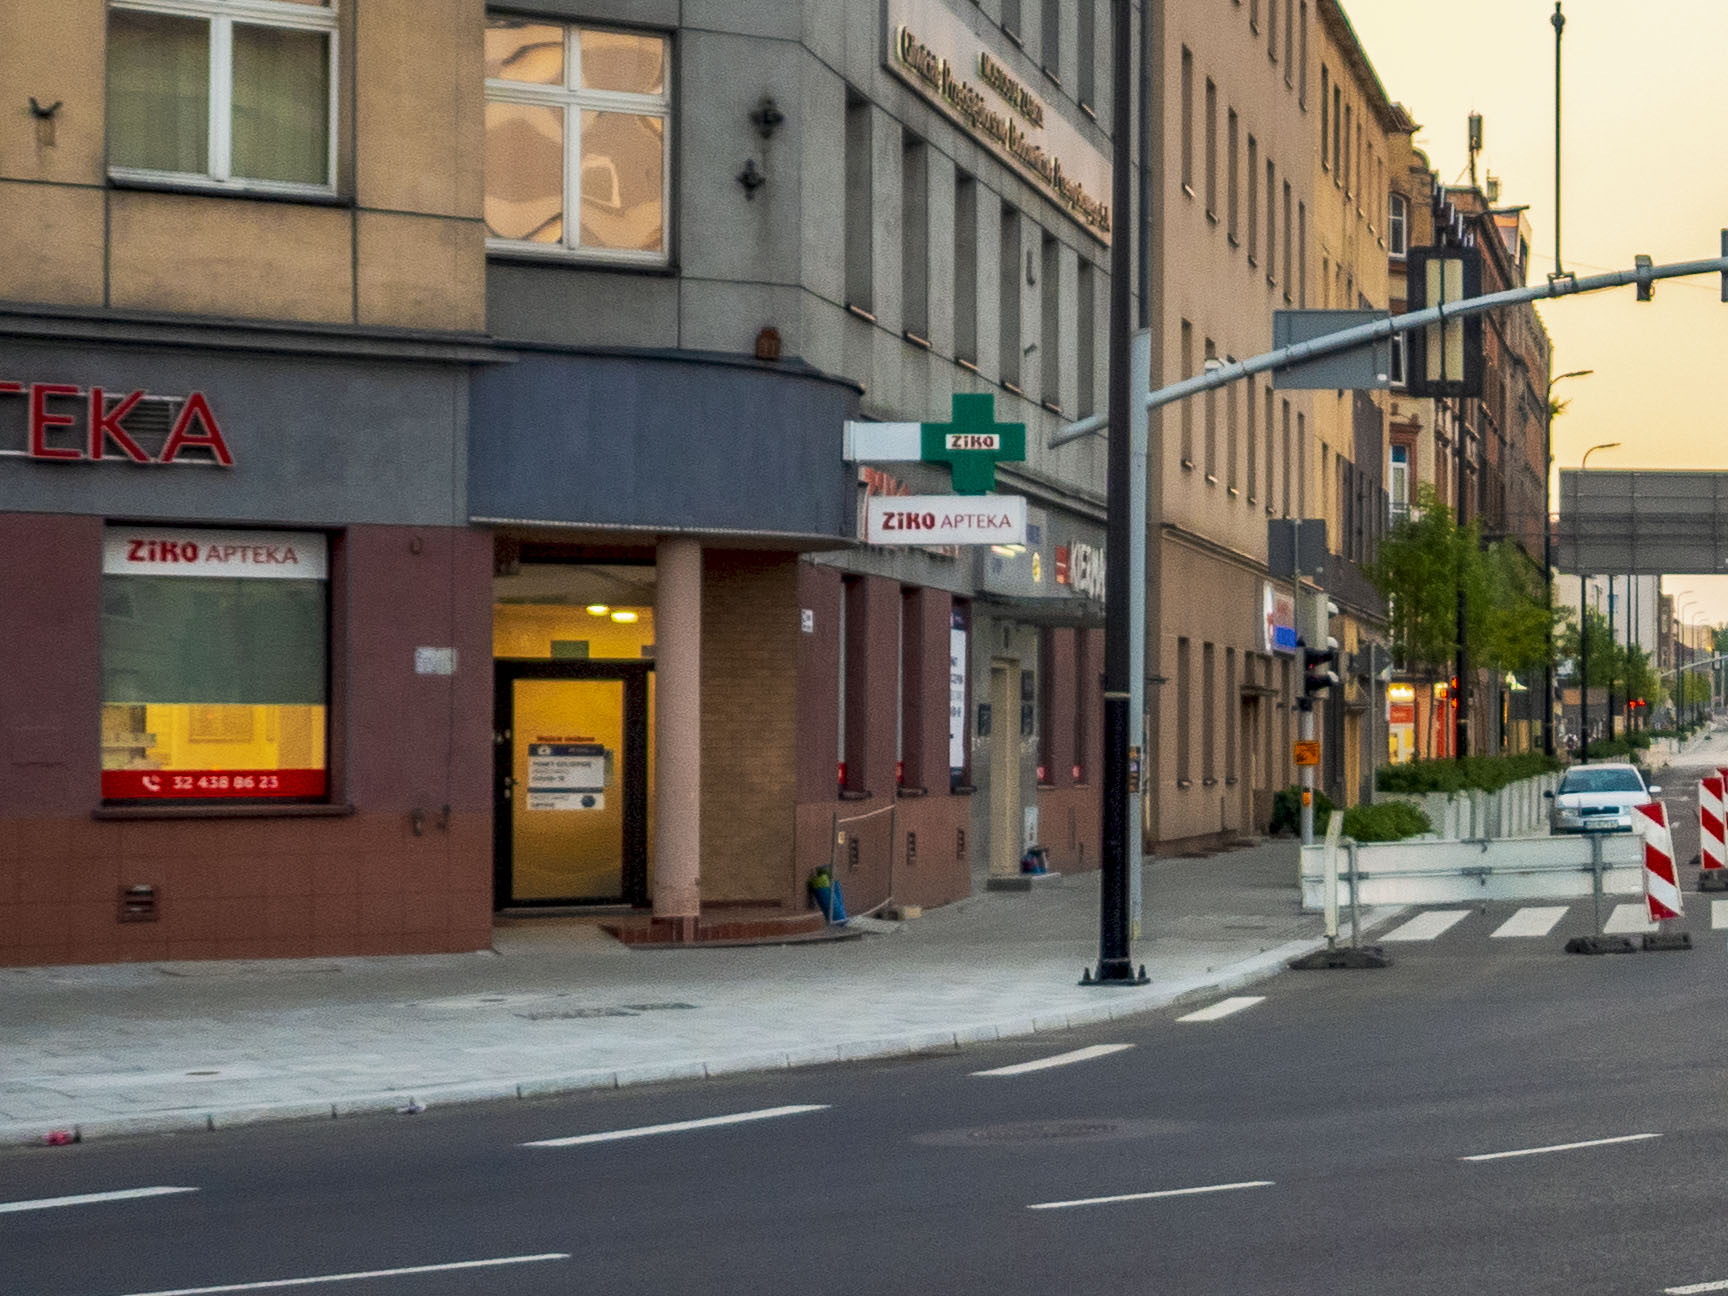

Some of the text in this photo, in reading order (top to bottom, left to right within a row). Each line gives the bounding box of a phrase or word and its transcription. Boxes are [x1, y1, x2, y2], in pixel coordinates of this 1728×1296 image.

[940, 513, 1012, 529] APTEKA
[205, 544, 298, 564] APTEKA
[173, 776, 193, 789] 32
